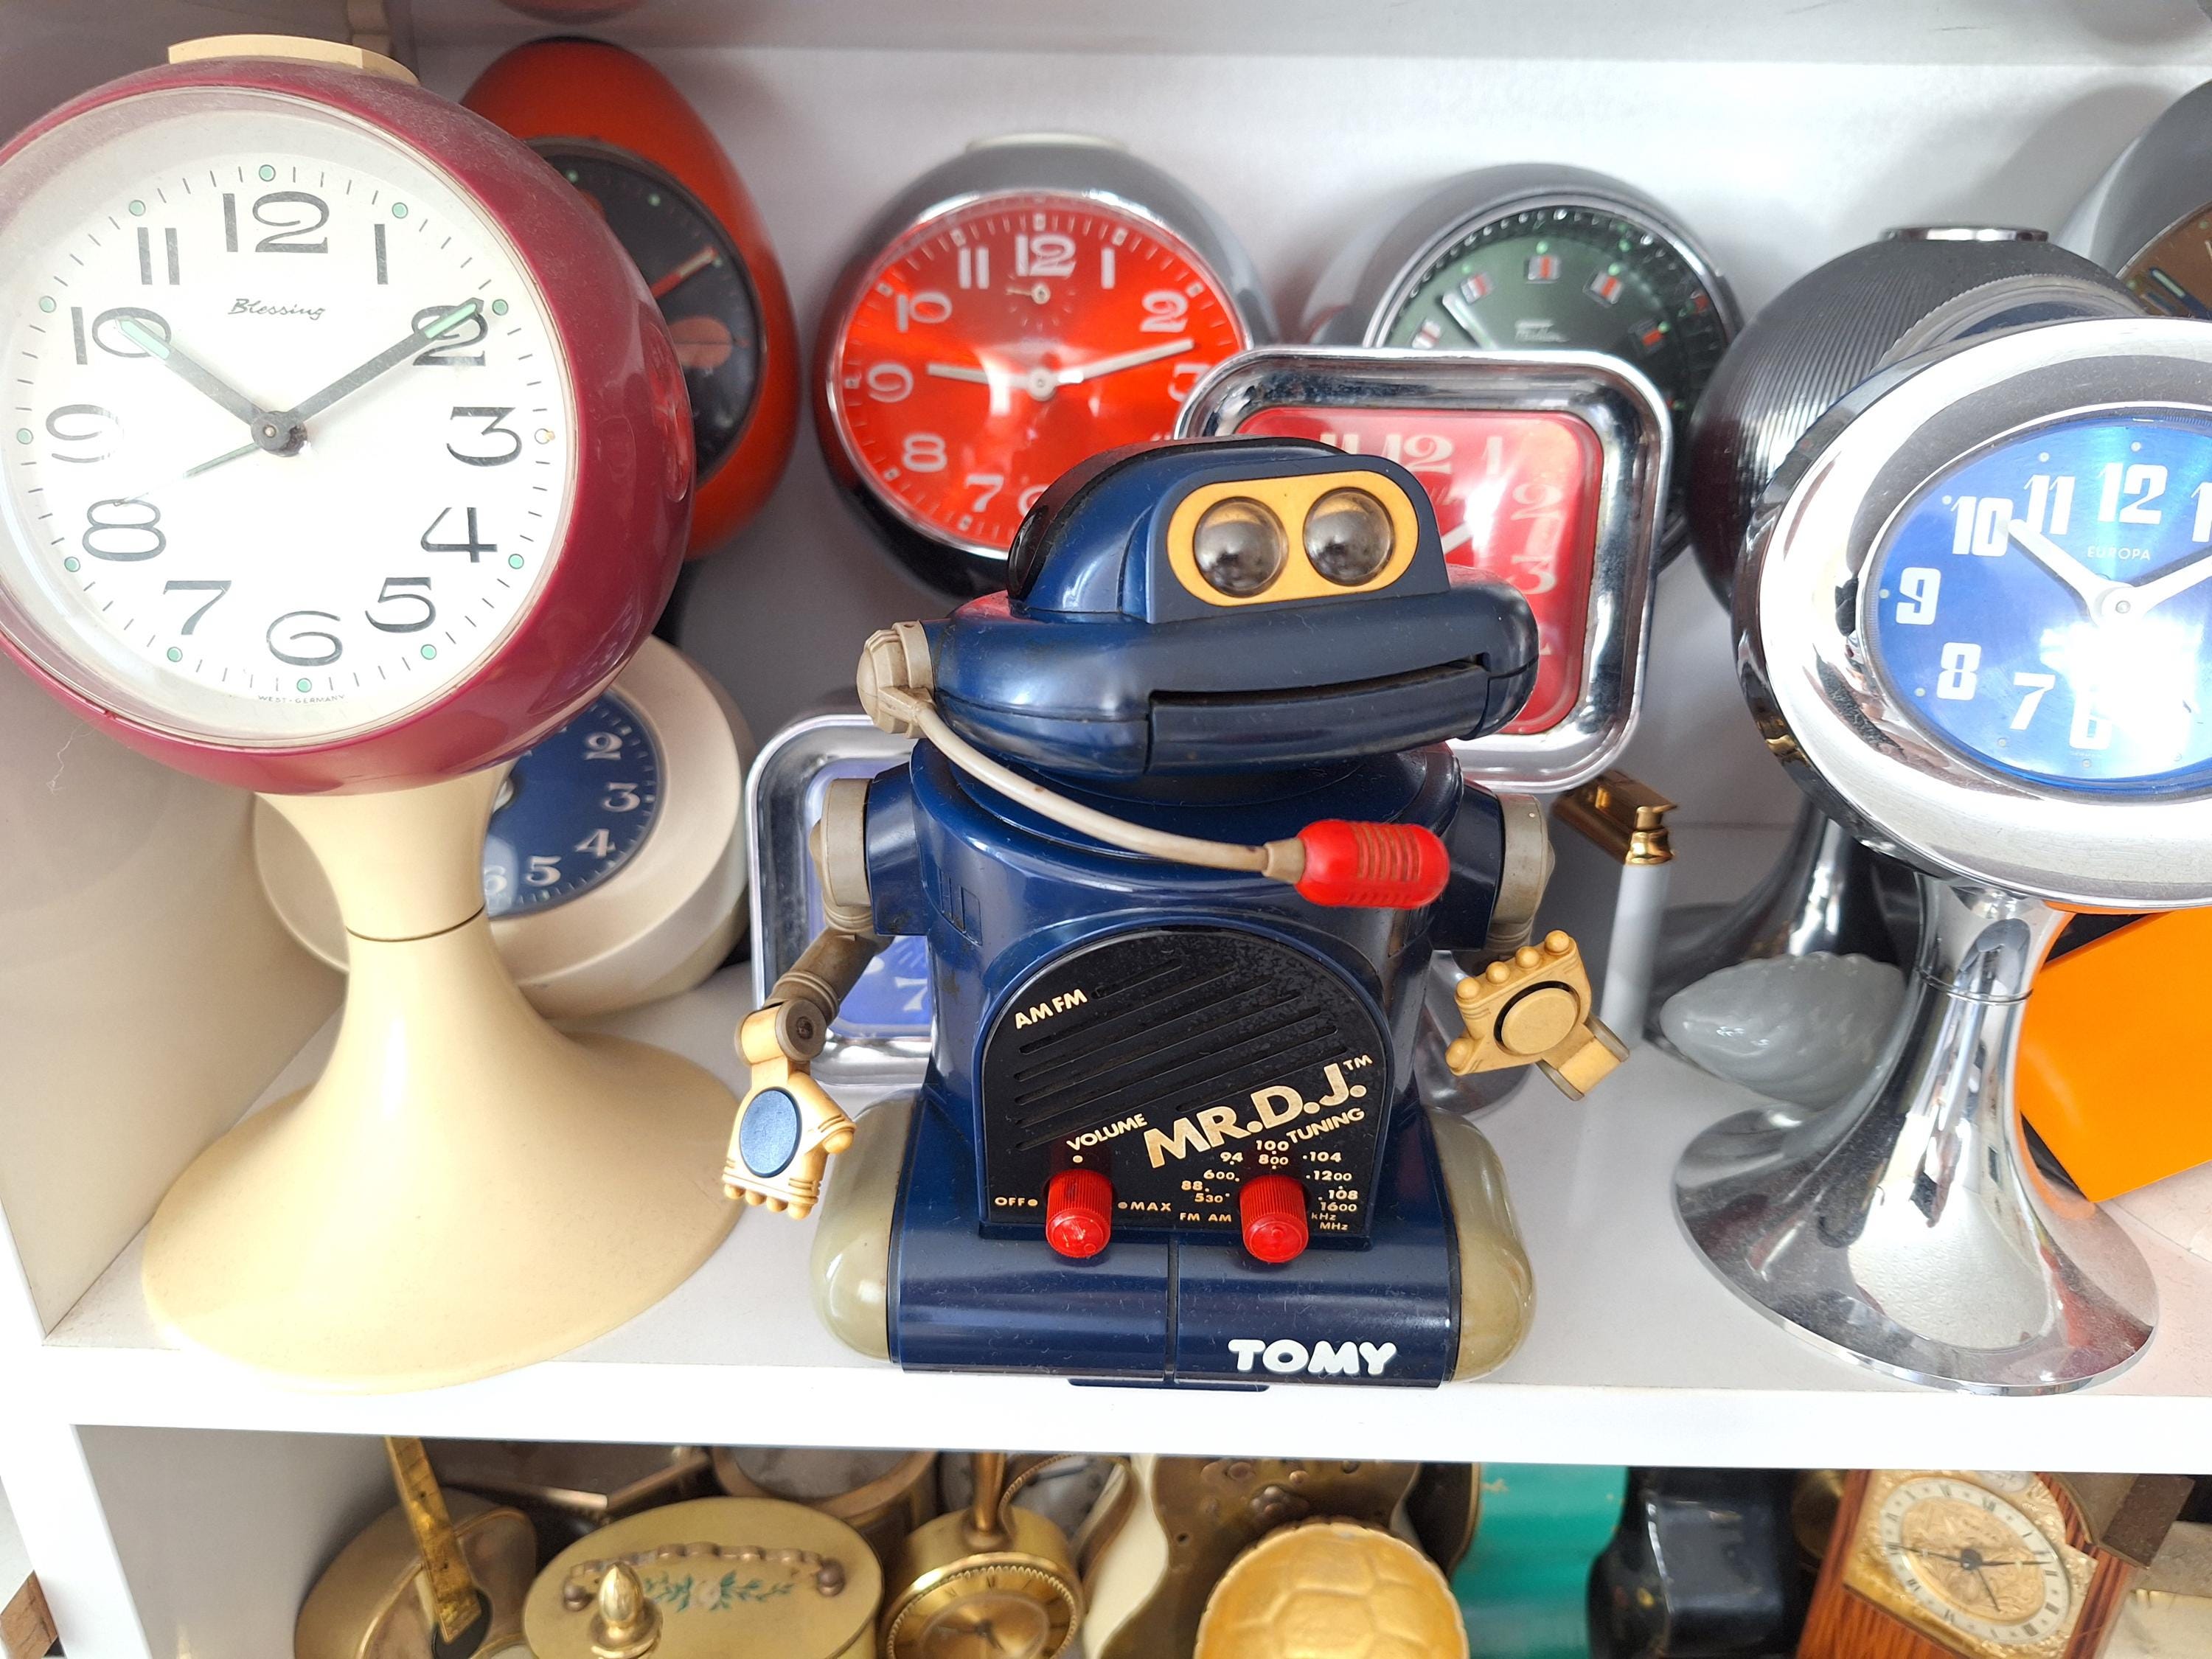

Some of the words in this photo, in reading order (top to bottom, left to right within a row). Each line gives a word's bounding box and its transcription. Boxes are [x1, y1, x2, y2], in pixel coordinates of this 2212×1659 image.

[223, 191, 330, 253] 12
[137, 227, 180, 285] 11
[375, 223, 389, 285] 1
[960, 247, 990, 289] 11
[1015, 234, 1077, 276] 12
[1102, 247, 1115, 289] 1
[228, 298, 325, 320] Blessing
[897, 293, 952, 333] 10
[1140, 291, 1189, 333] 2
[71, 306, 172, 365] 10
[411, 302, 488, 366] 2
[867, 363, 914, 403] 9
[46, 404, 124, 464] 9
[446, 406, 523, 467] 3
[902, 433, 947, 473] 8
[1380, 434, 1455, 473] 12
[1481, 436, 1503, 476] 1
[964, 474, 1004, 512] 7
[1511, 483, 1562, 521] 2
[2023, 474, 2075, 535] 11
[2097, 462, 2168, 524] 12
[2191, 481, 2212, 543] 1
[82, 498, 167, 562] 8
[420, 507, 498, 563] 4
[1951, 495, 2014, 557] 10
[2087, 546, 2151, 561] EUROPA
[1507, 554, 1556, 594] 3
[163, 580, 232, 636] 7
[365, 577, 437, 633] 5
[1896, 567, 1941, 625] 9
[266, 610, 343, 666] 6
[1936, 642, 1982, 700] 8
[2009, 672, 2056, 730] 7
[585, 731, 622, 760] 2
[603, 782, 640, 812] 3
[575, 829, 616, 858] 4
[526, 855, 562, 886] 5
[1066, 1113, 1147, 1150] VOLUME
[1286, 1107, 1365, 1143] TUNING
[1220, 1152, 1244, 1163] 94
[1256, 1140, 1290, 1152] 100
[1258, 1154, 1289, 1165] 800
[1310, 1151, 1342, 1163] 104
[1181, 1180, 1203, 1191] 88
[1203, 1169, 1235, 1180] 600
[1313, 1170, 1352, 1181] 1200
[1329, 1189, 1358, 1200] 108
[995, 1197, 1026, 1207] OFF
[1130, 1201, 1172, 1212] MAX
[1180, 1212, 1200, 1221] FM
[1208, 1213, 1232, 1222] AM
[1194, 1193, 1223, 1203] 530
[1311, 1211, 1337, 1221] kHz
[1321, 1201, 1357, 1211] 1600
[1320, 1221, 1349, 1231] MHz
[1228, 1339, 1397, 1376] TOMY
